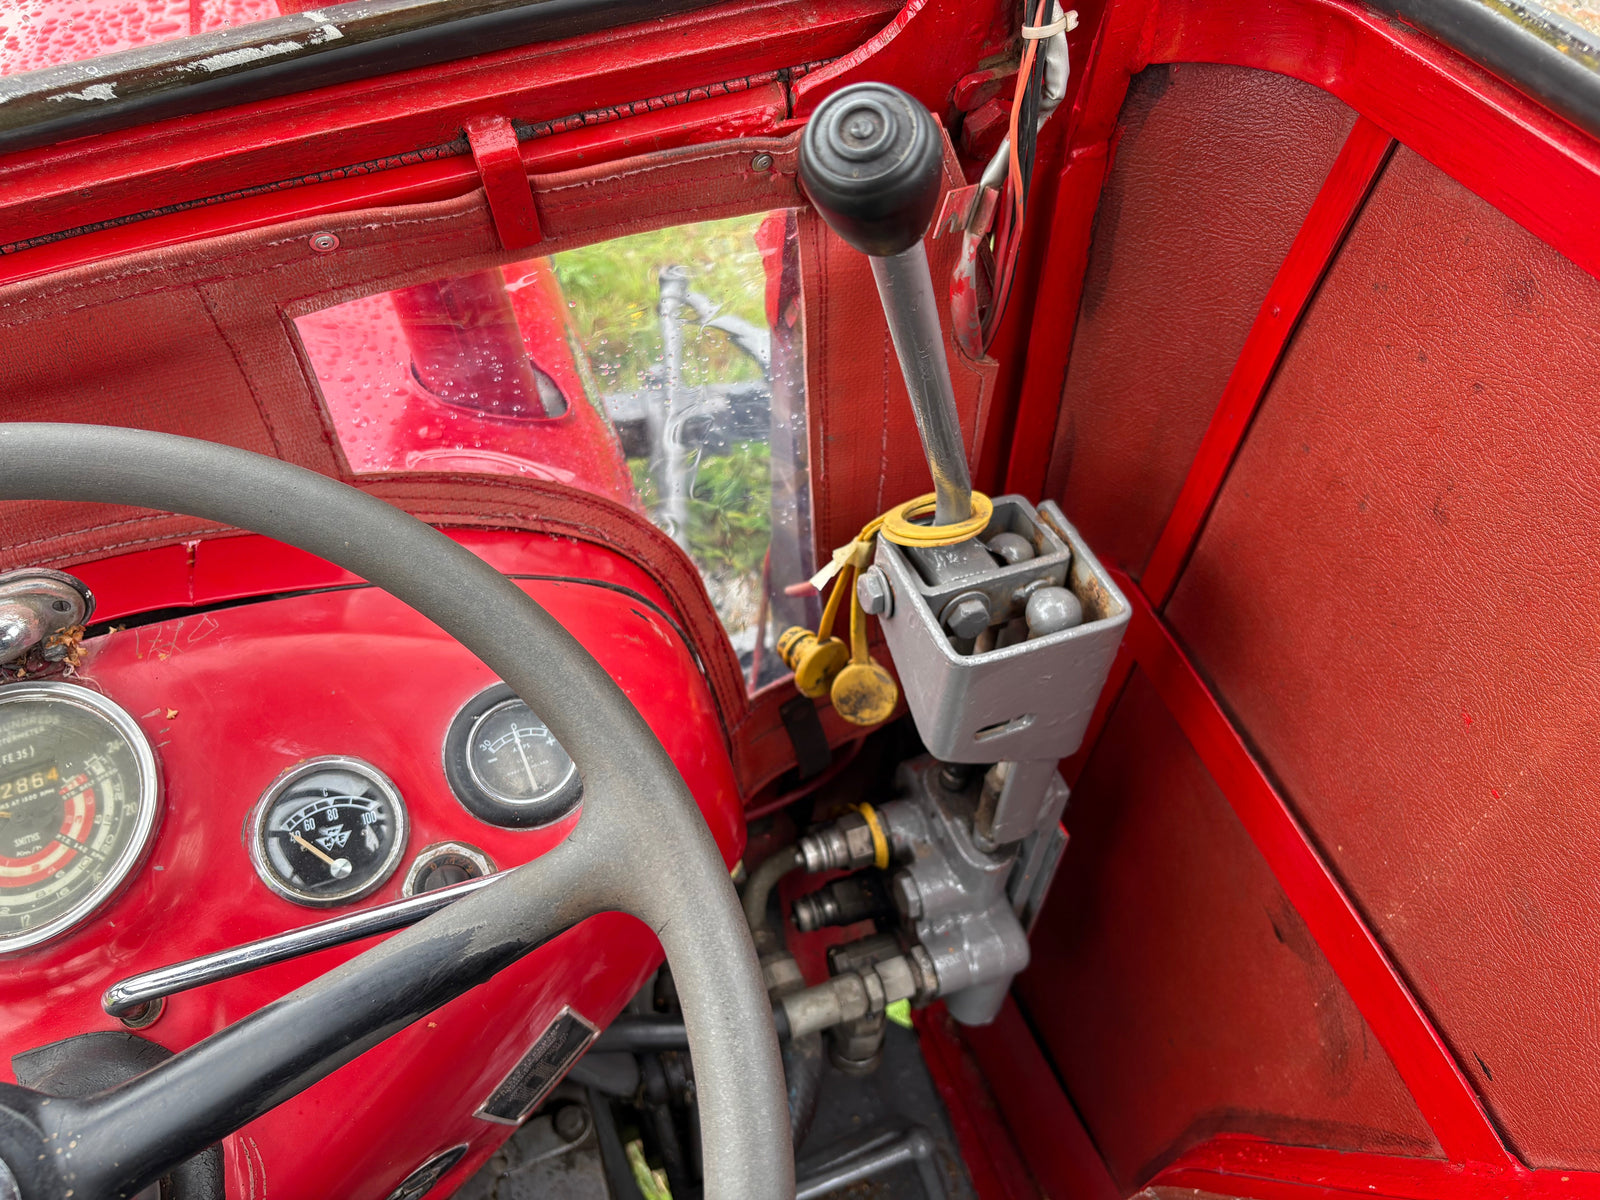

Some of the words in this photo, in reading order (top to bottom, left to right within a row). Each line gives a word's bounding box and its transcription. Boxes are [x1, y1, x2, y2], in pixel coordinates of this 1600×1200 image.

[479, 739, 492, 752] 30
[326, 807, 339, 822] 80
[361, 810, 378, 825] 100
[303, 817, 316, 832] 60
[14, 832, 41, 848] SMITHS
